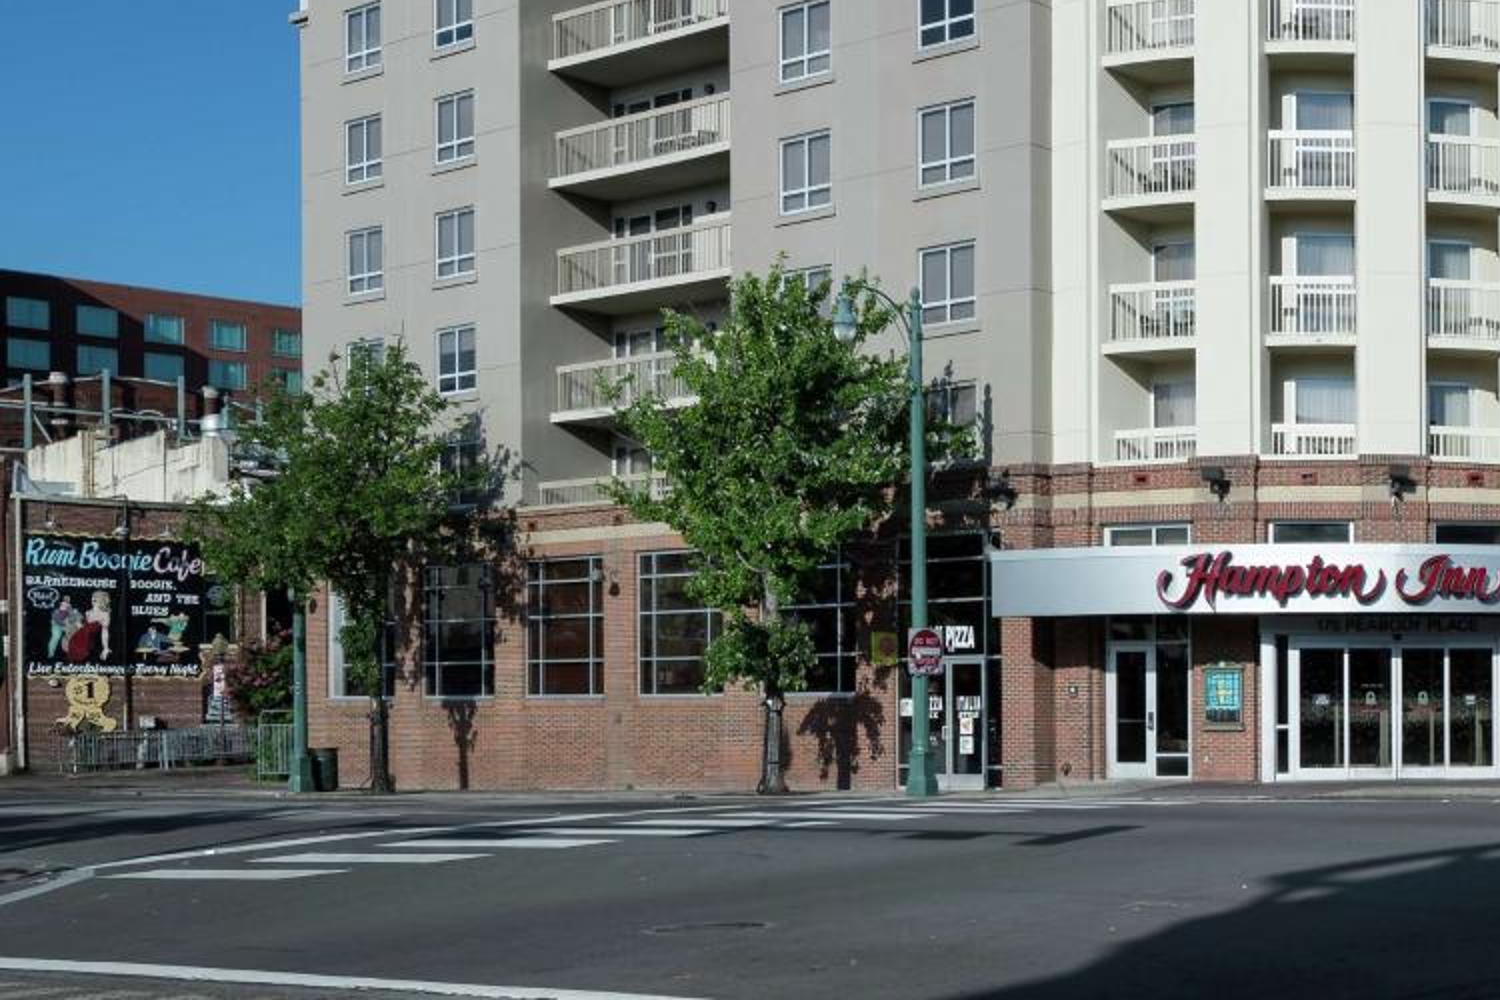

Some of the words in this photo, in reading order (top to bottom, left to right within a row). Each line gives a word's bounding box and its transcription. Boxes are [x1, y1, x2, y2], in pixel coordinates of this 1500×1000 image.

[26, 538, 77, 566] Rum
[1157, 551, 1388, 613] Hampton
[145, 593, 172, 604] AND
[175, 594, 200, 605] THE
[131, 605, 169, 616] BLUES
[945, 625, 975, 650] PIZZA
[29, 662, 52, 674] Live
[135, 663, 167, 676] Every
[169, 664, 199, 677] Night
